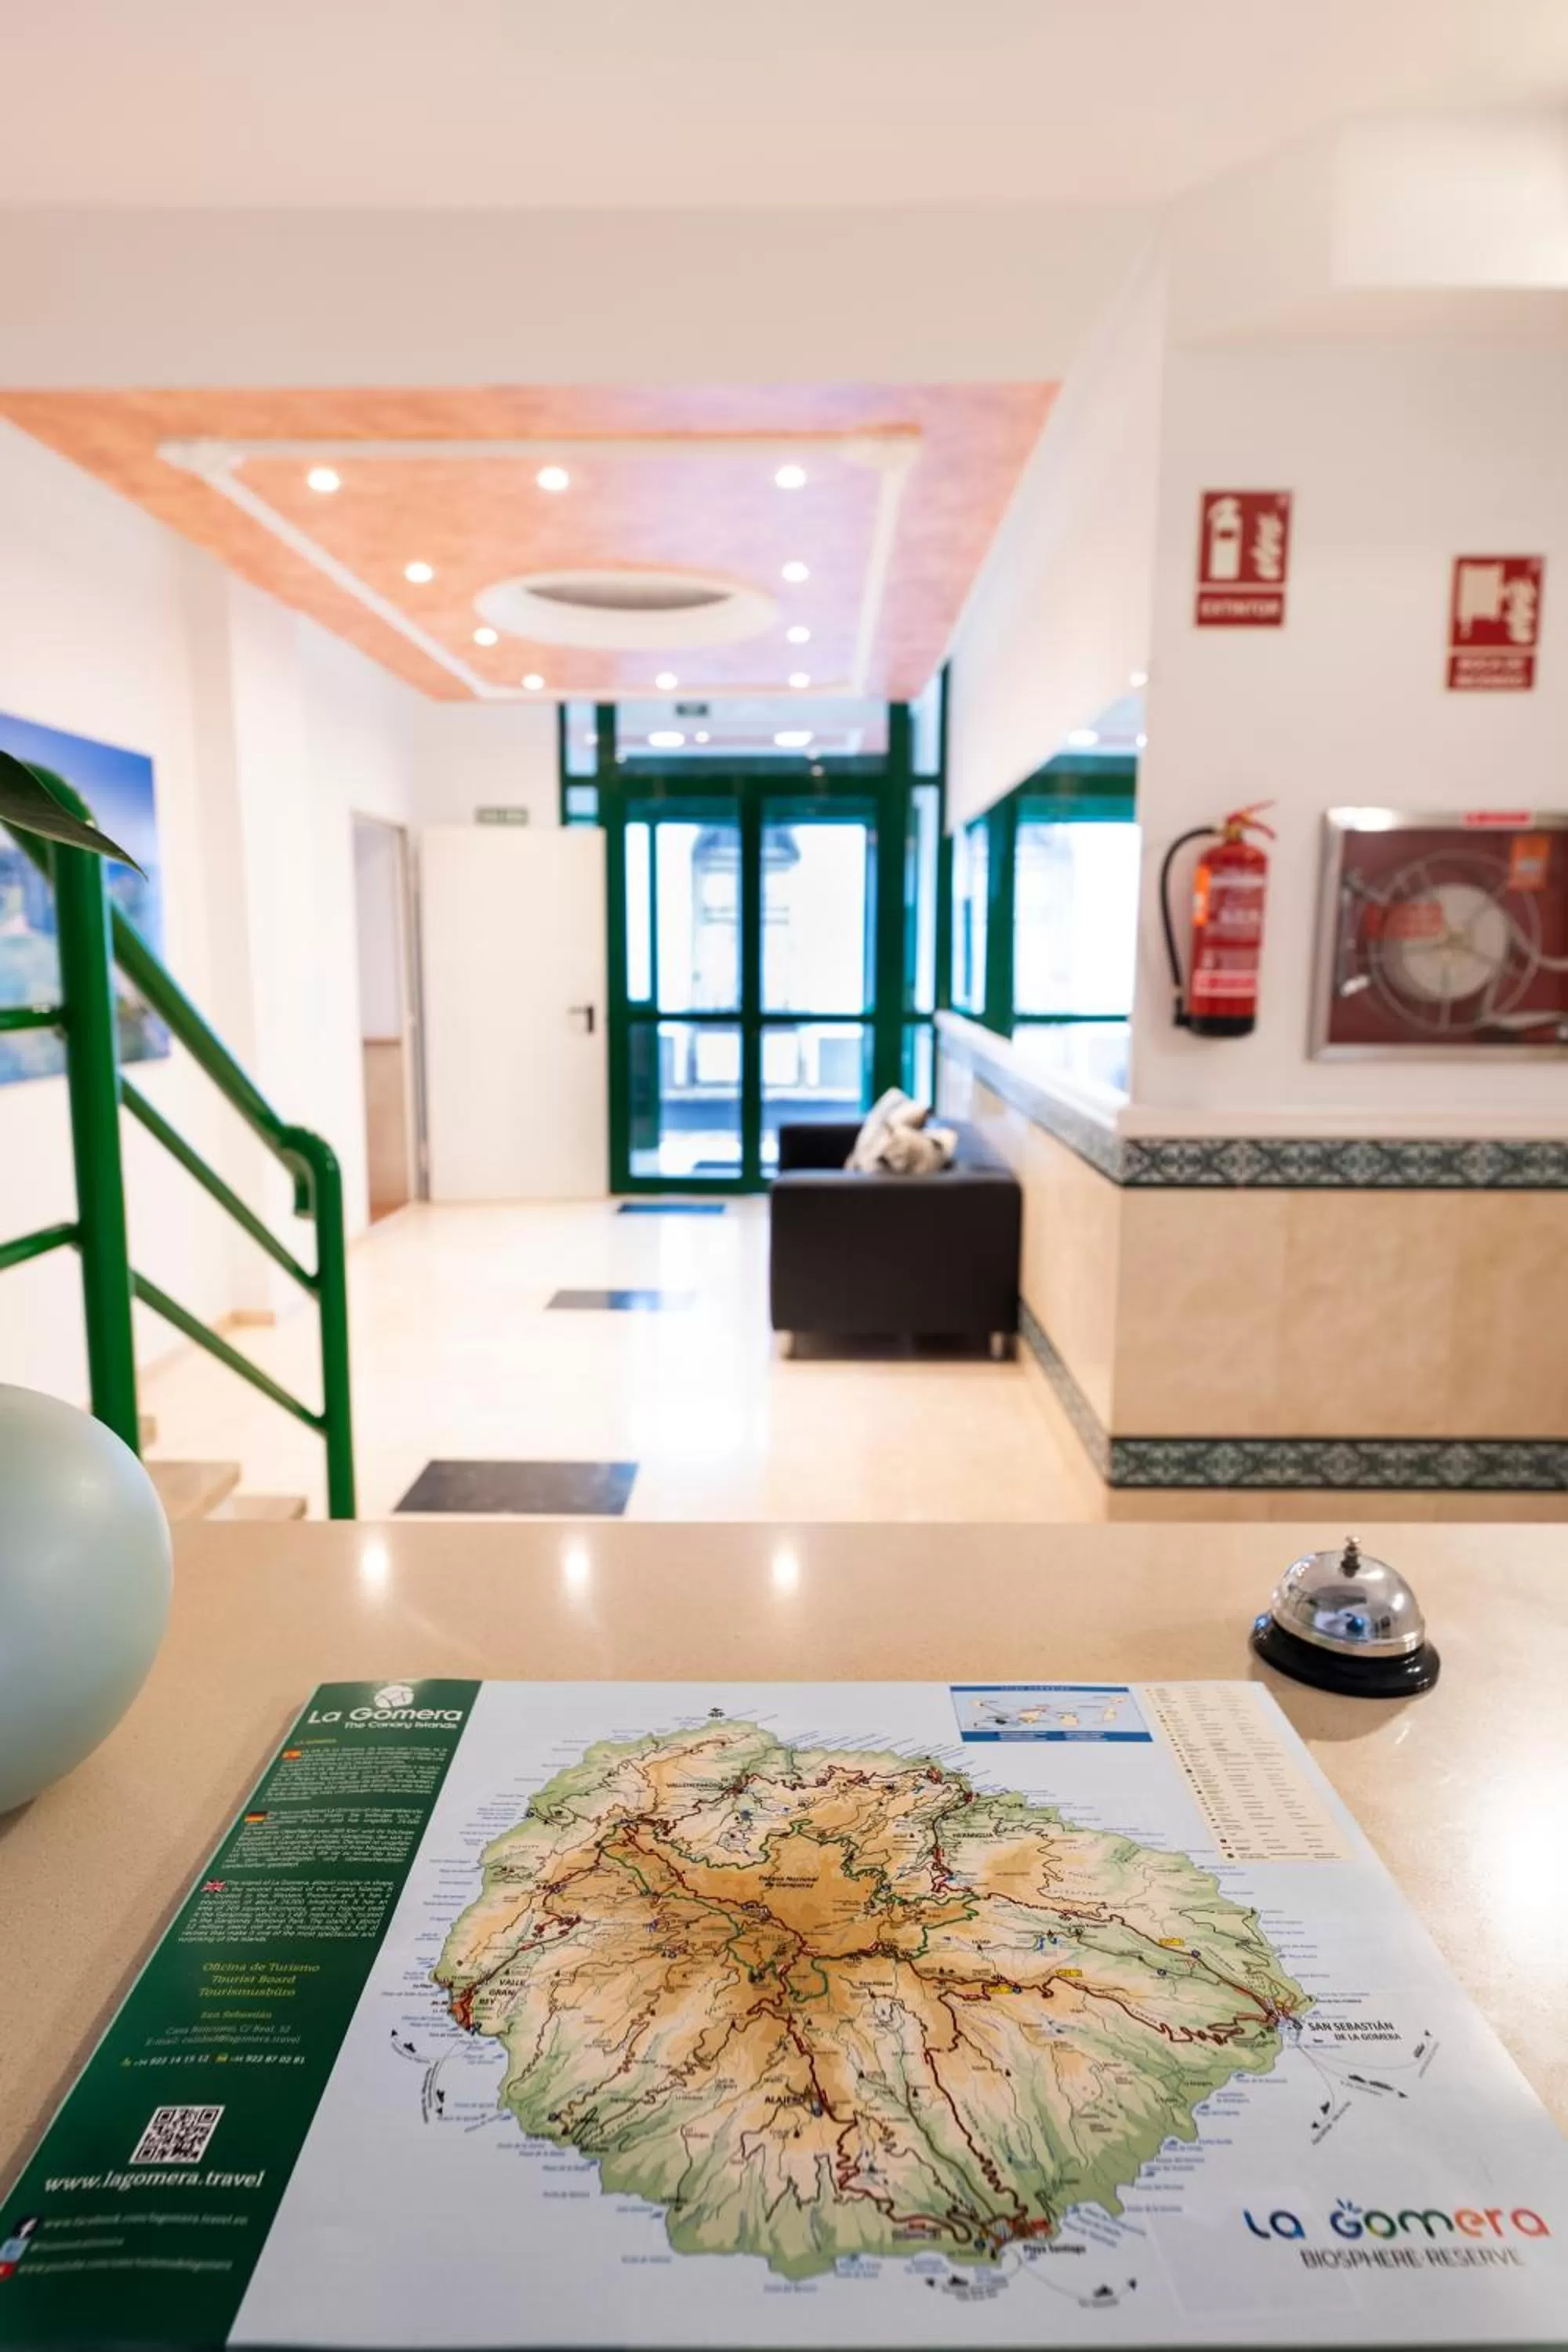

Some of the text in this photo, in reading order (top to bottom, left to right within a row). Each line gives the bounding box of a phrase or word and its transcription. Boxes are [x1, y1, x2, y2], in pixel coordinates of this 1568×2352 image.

[307, 1707, 463, 1724] La Gomera
[368, 1721, 413, 1730] Canary
[414, 1721, 458, 1730] Islands
[203, 1962, 321, 1972] Oficina de Turismo
[212, 1975, 297, 1984] Tourist Board
[1308, 2022, 1332, 2031] SAN
[45, 2169, 266, 2192] www.lagomera.travel
[1243, 2205, 1553, 2241] La Gomera
[1300, 2246, 1526, 2270] BIOSPHERE RESERVE
